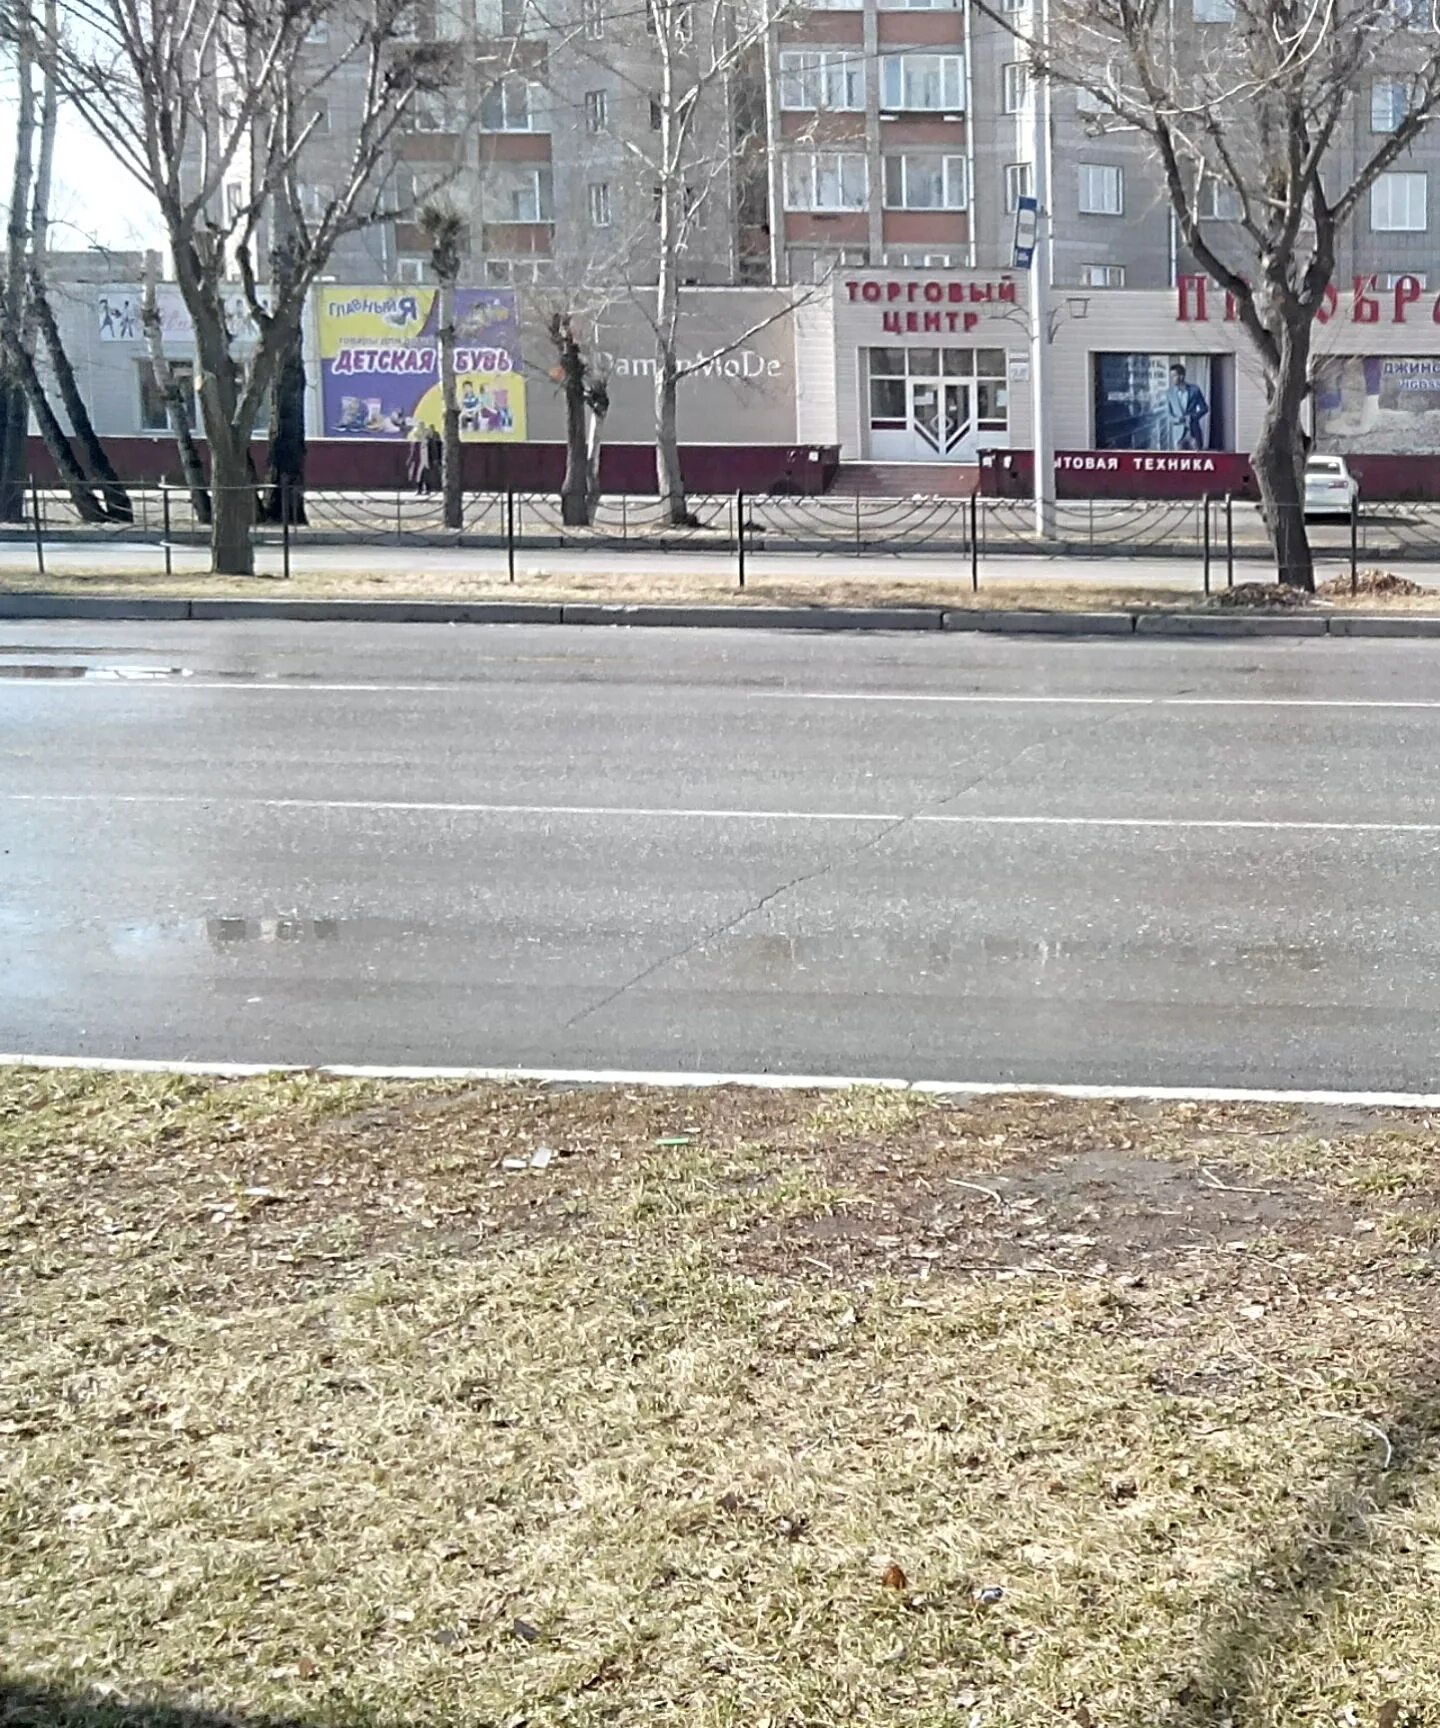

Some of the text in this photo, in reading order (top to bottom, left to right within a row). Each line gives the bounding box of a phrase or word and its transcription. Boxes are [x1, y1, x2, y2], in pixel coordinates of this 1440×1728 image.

[846, 275, 1016, 302] ТОРГОВЫЙ
[882, 311, 979, 335] ЦЕНТР
[332, 348, 514, 375] ДЕТСКАЯ БУВЬ
[1054, 456, 1215, 471] ЫТОВАЯ ТЕХНИКА
